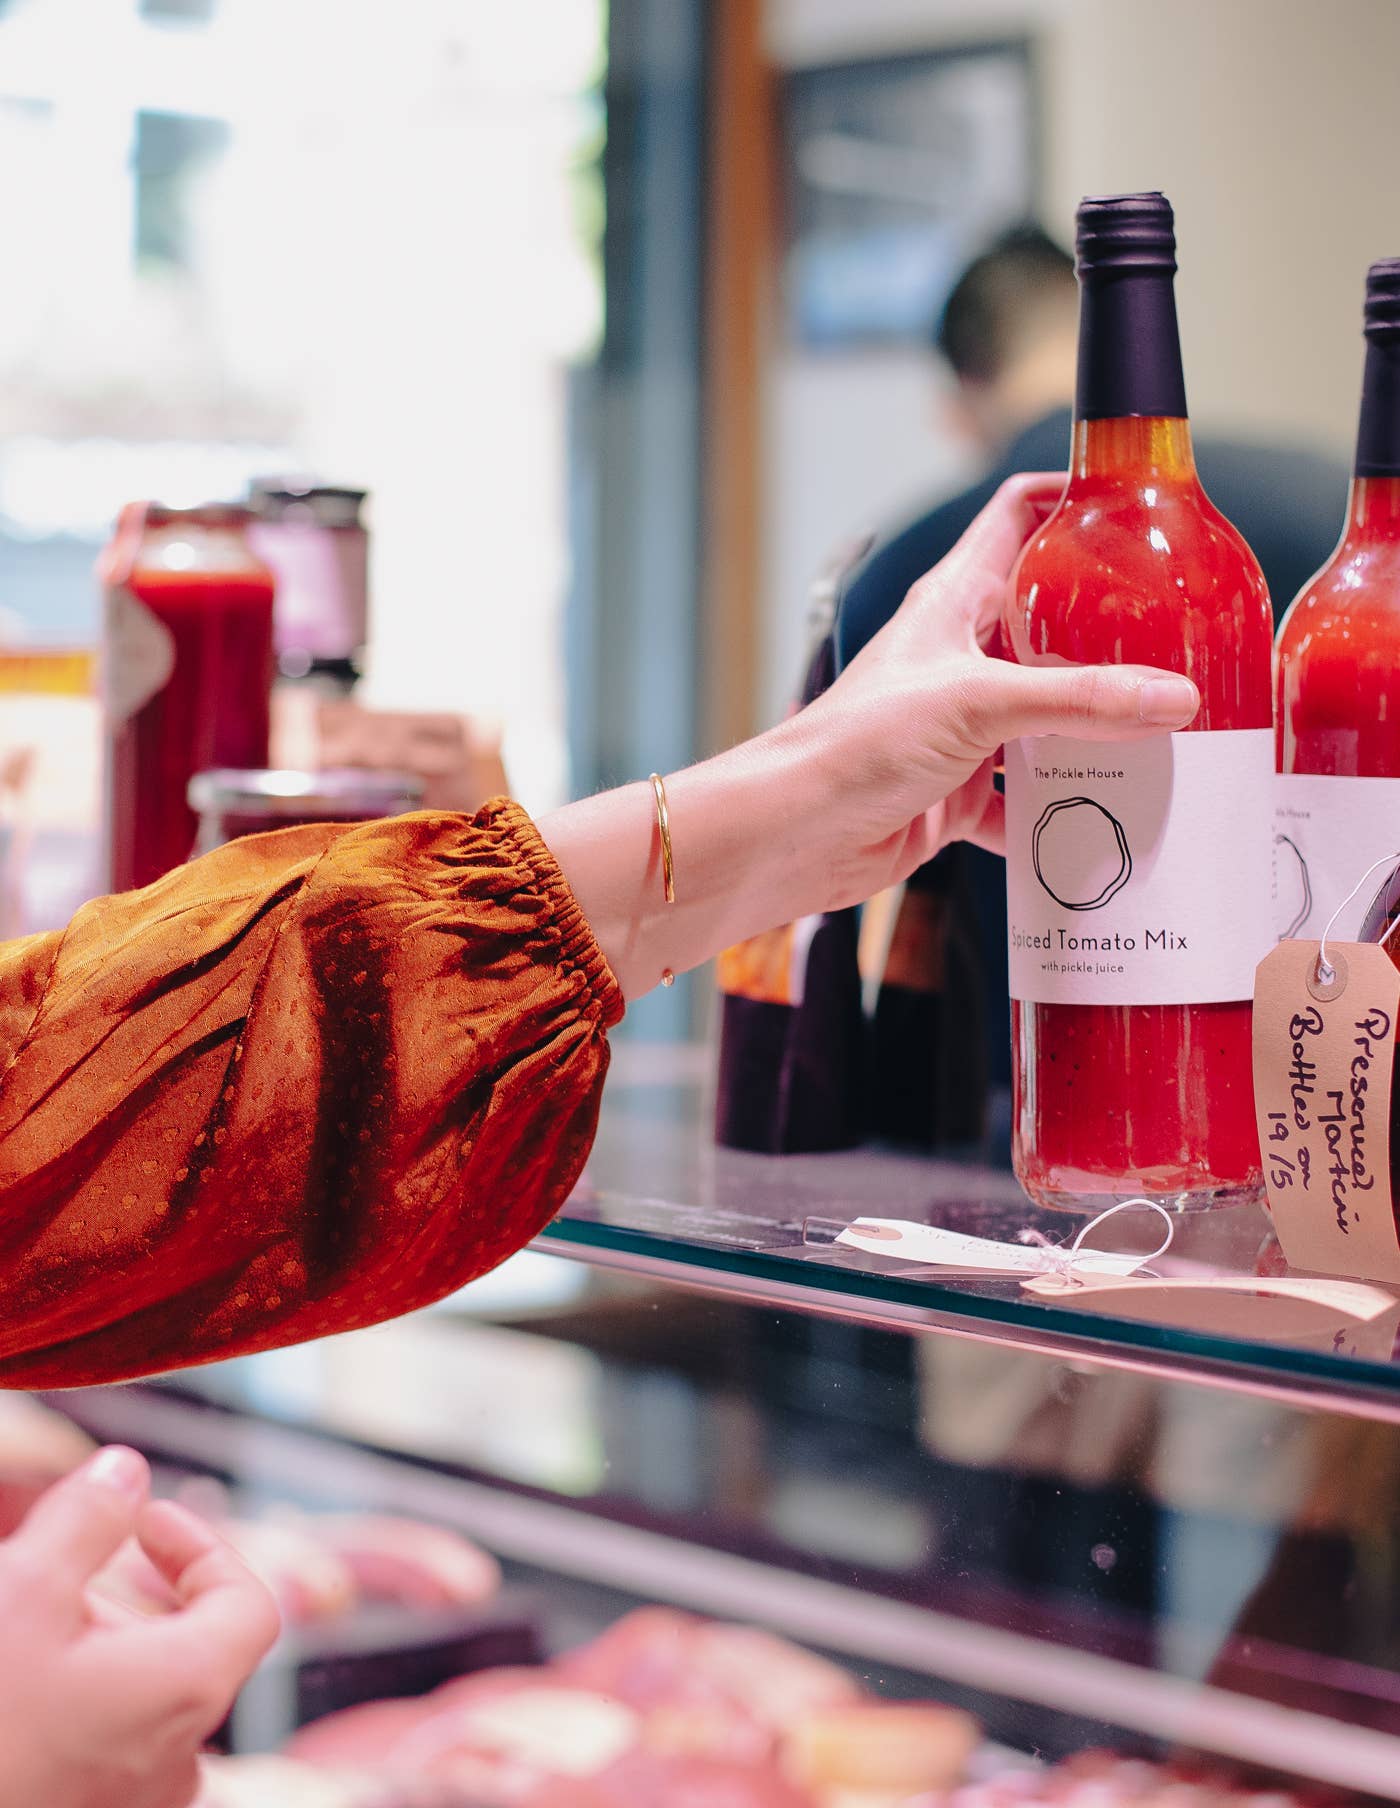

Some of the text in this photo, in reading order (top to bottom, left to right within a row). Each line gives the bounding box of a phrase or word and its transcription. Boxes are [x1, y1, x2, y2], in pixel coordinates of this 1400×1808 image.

[1034, 767, 1125, 779] The Pickle House
[1012, 926, 1188, 951] Spiced Tomato Mix
[1041, 961, 1125, 975] with pickle juice
[1288, 1005, 1324, 1192] Bottled on
